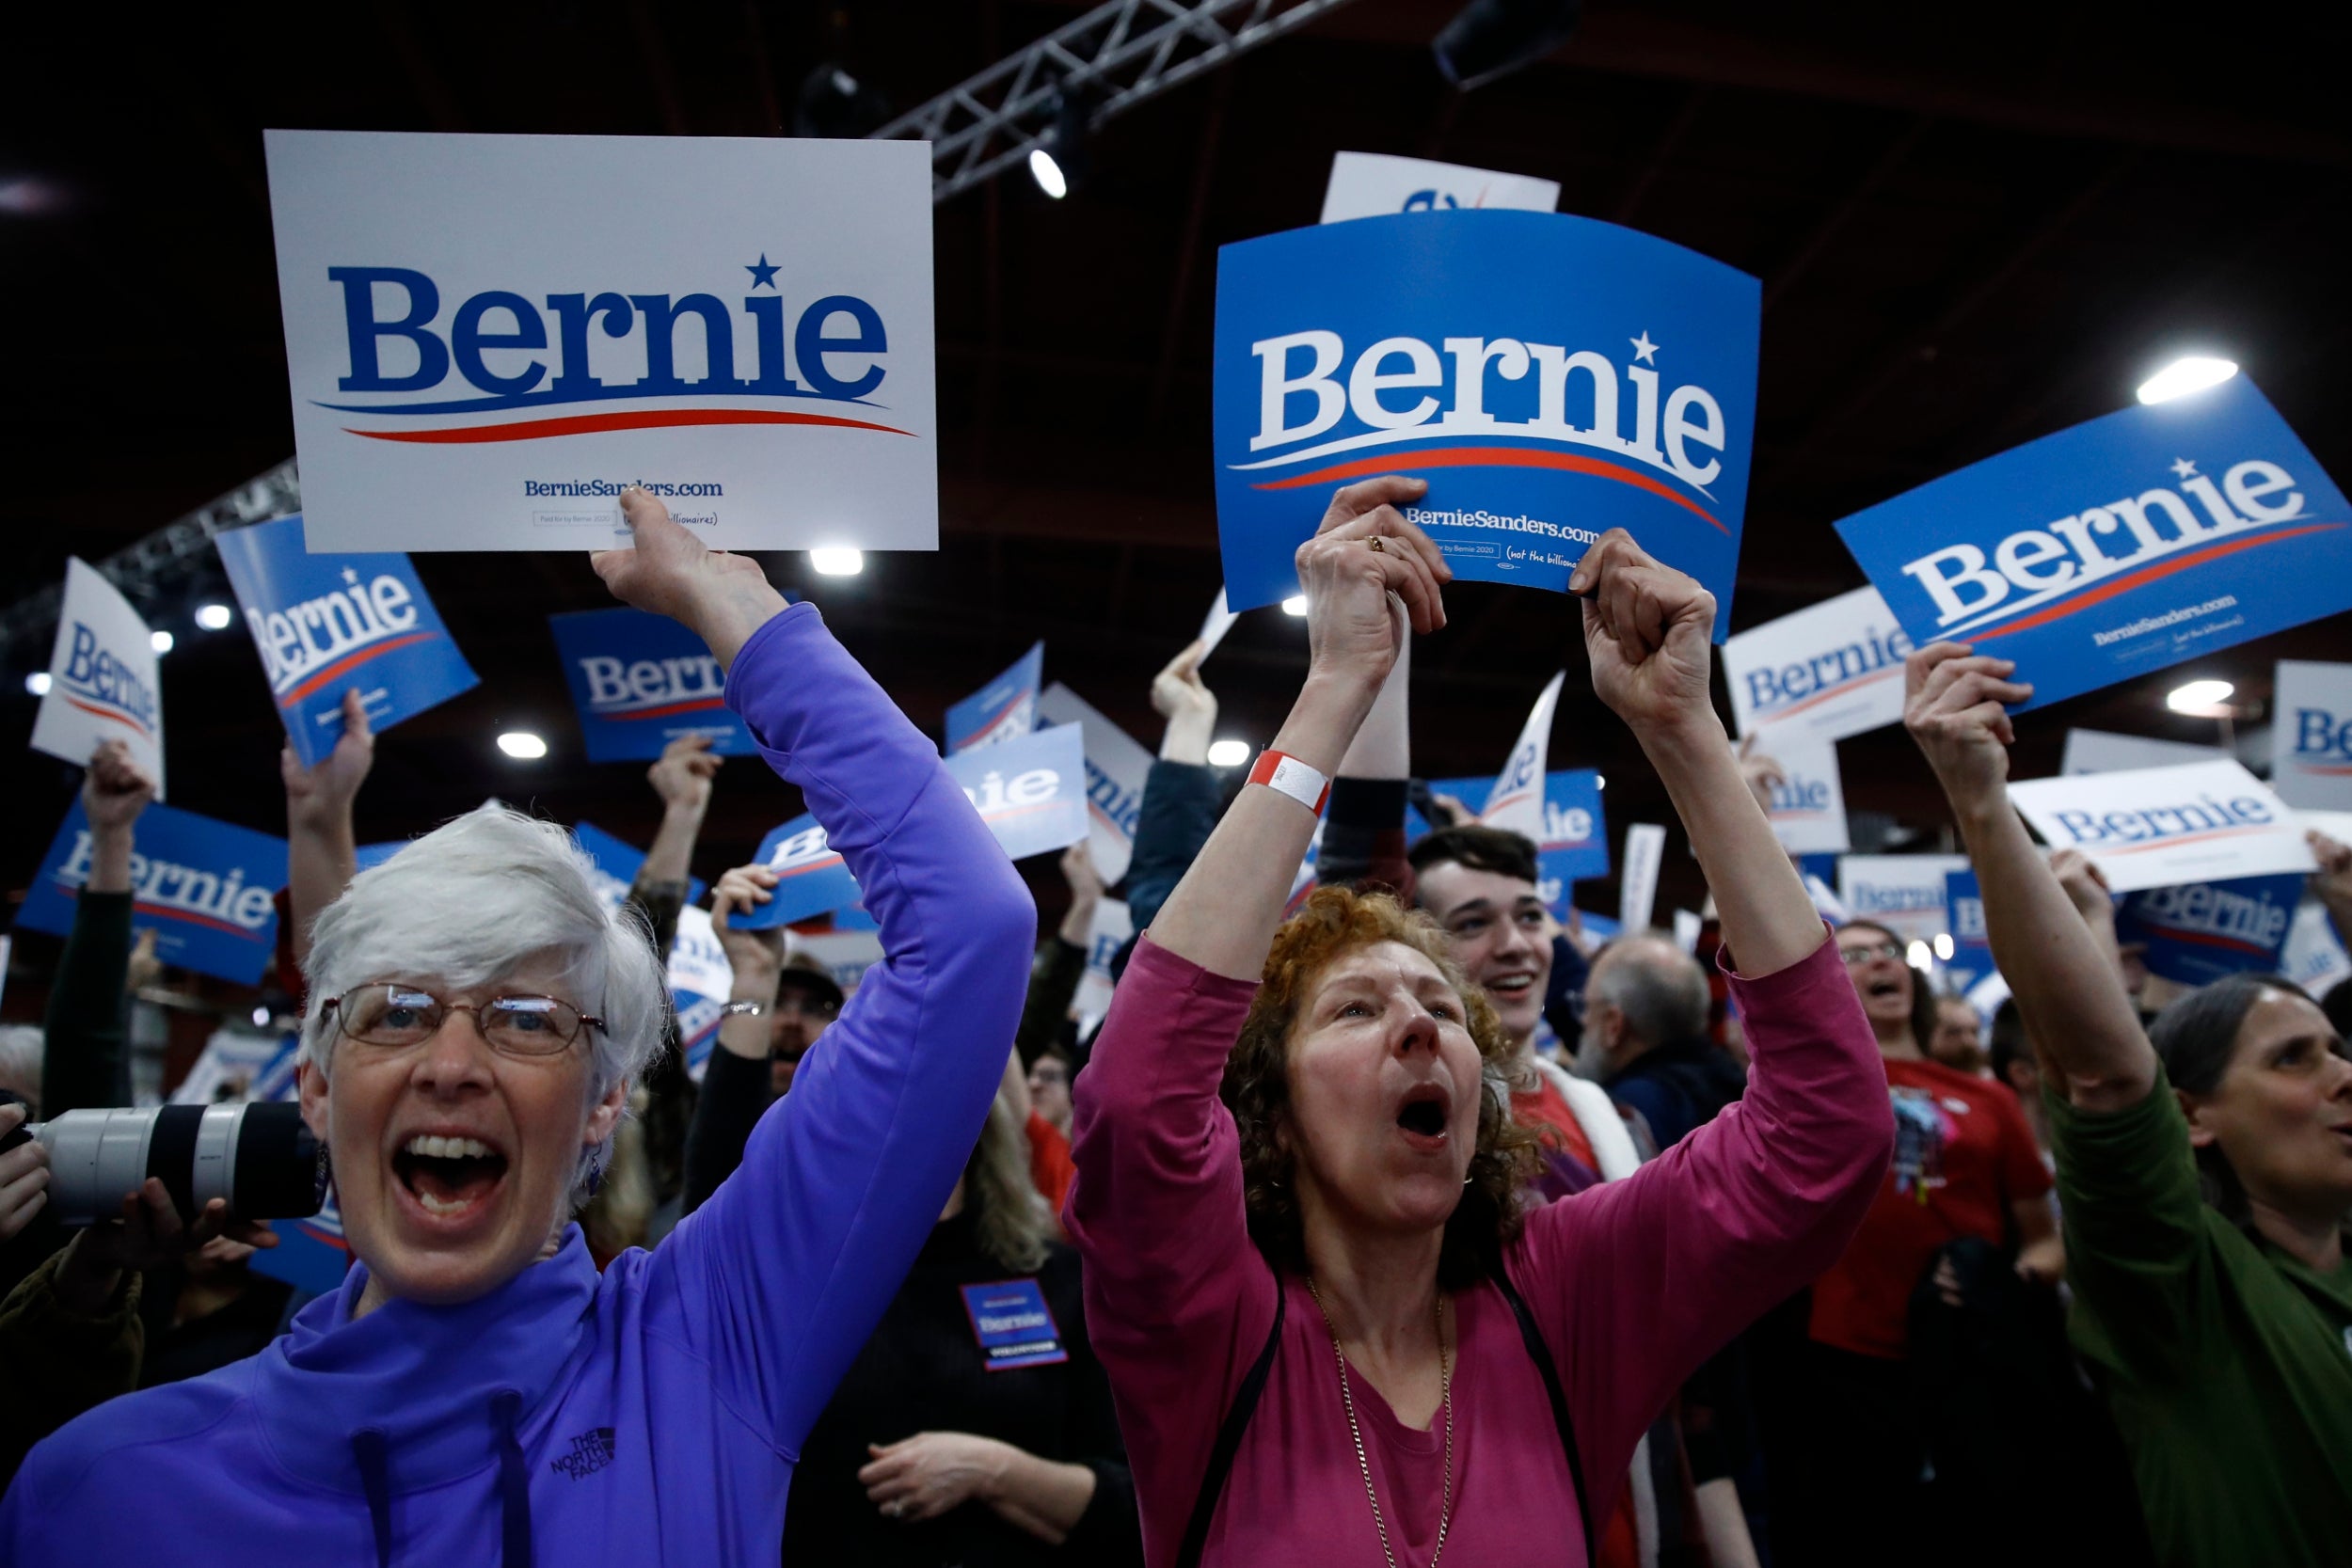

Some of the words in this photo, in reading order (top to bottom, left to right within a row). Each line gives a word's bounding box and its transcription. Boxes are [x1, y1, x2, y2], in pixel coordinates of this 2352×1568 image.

[327, 252, 888, 399] Bernie
[1249, 329, 1725, 486] Bernie
[668, 512, 718, 526] illionaires)
[1406, 507, 1600, 545] BernieSanders.com
[1476, 546, 1494, 554] 2020
[1506, 546, 1527, 561] (not
[1530, 550, 1545, 562] the
[1901, 457, 2305, 627] Bernie
[1746, 625, 1915, 708] Bernie
[2052, 794, 2275, 844] Bernie
[550, 1442, 604, 1474] NORTH
[570, 1430, 598, 1451] THE
[570, 1455, 610, 1481] FACE
